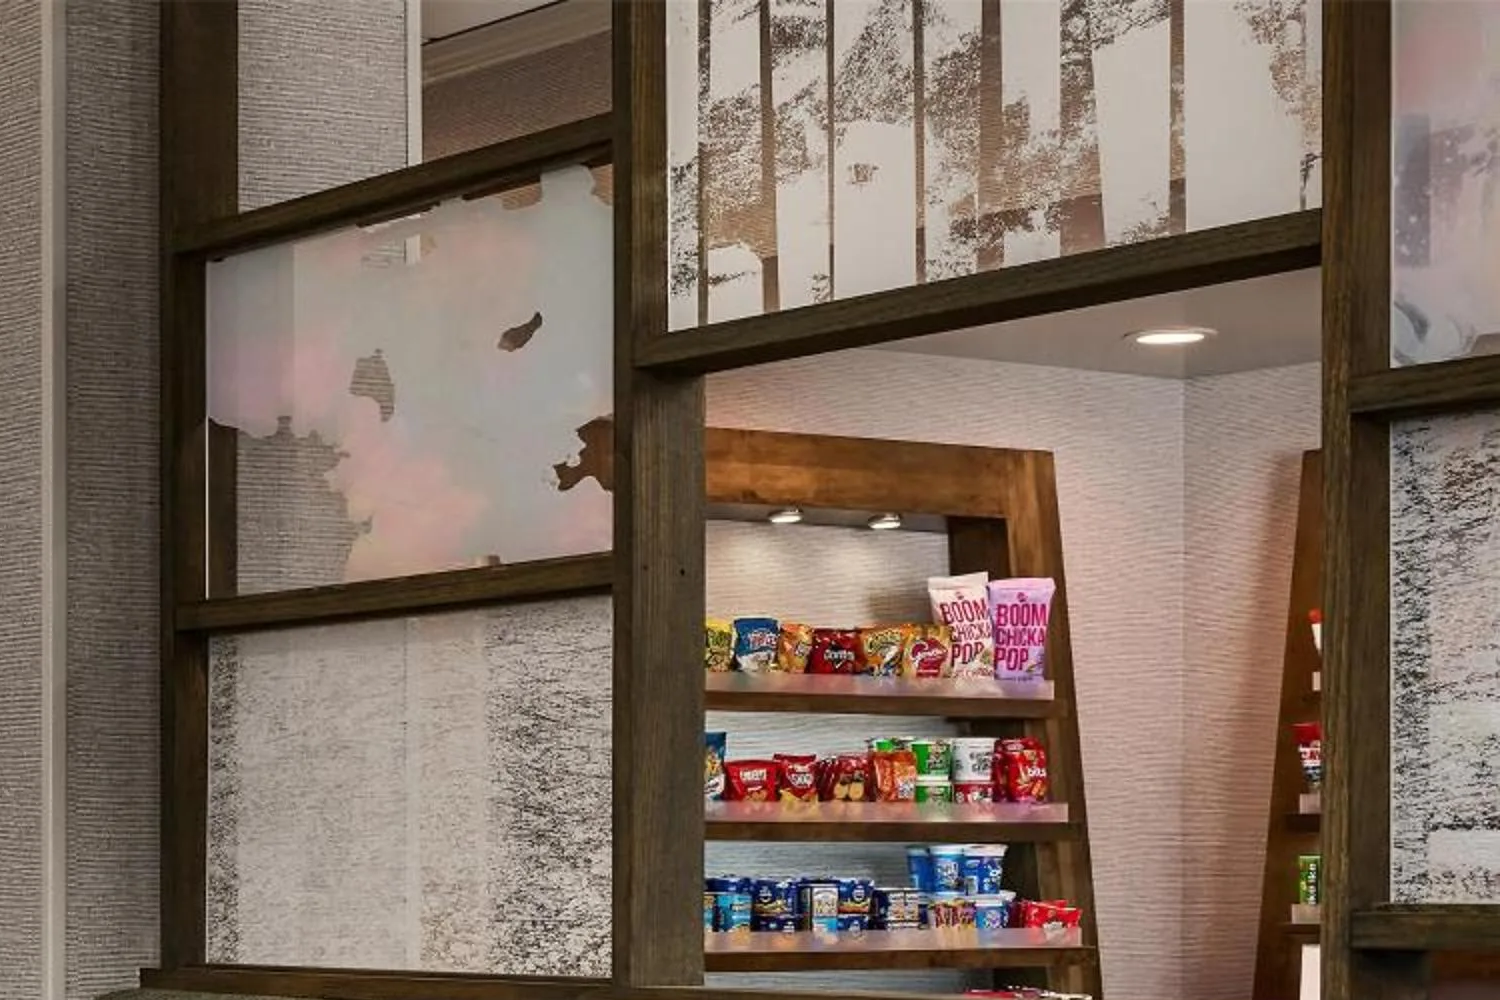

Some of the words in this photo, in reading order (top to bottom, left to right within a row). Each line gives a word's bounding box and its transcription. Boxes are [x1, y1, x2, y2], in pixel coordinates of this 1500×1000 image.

[996, 603, 1047, 626] BOOM
[995, 627, 1046, 647] CHICKA
[951, 642, 985, 667] POP
[995, 648, 1029, 671] POP
